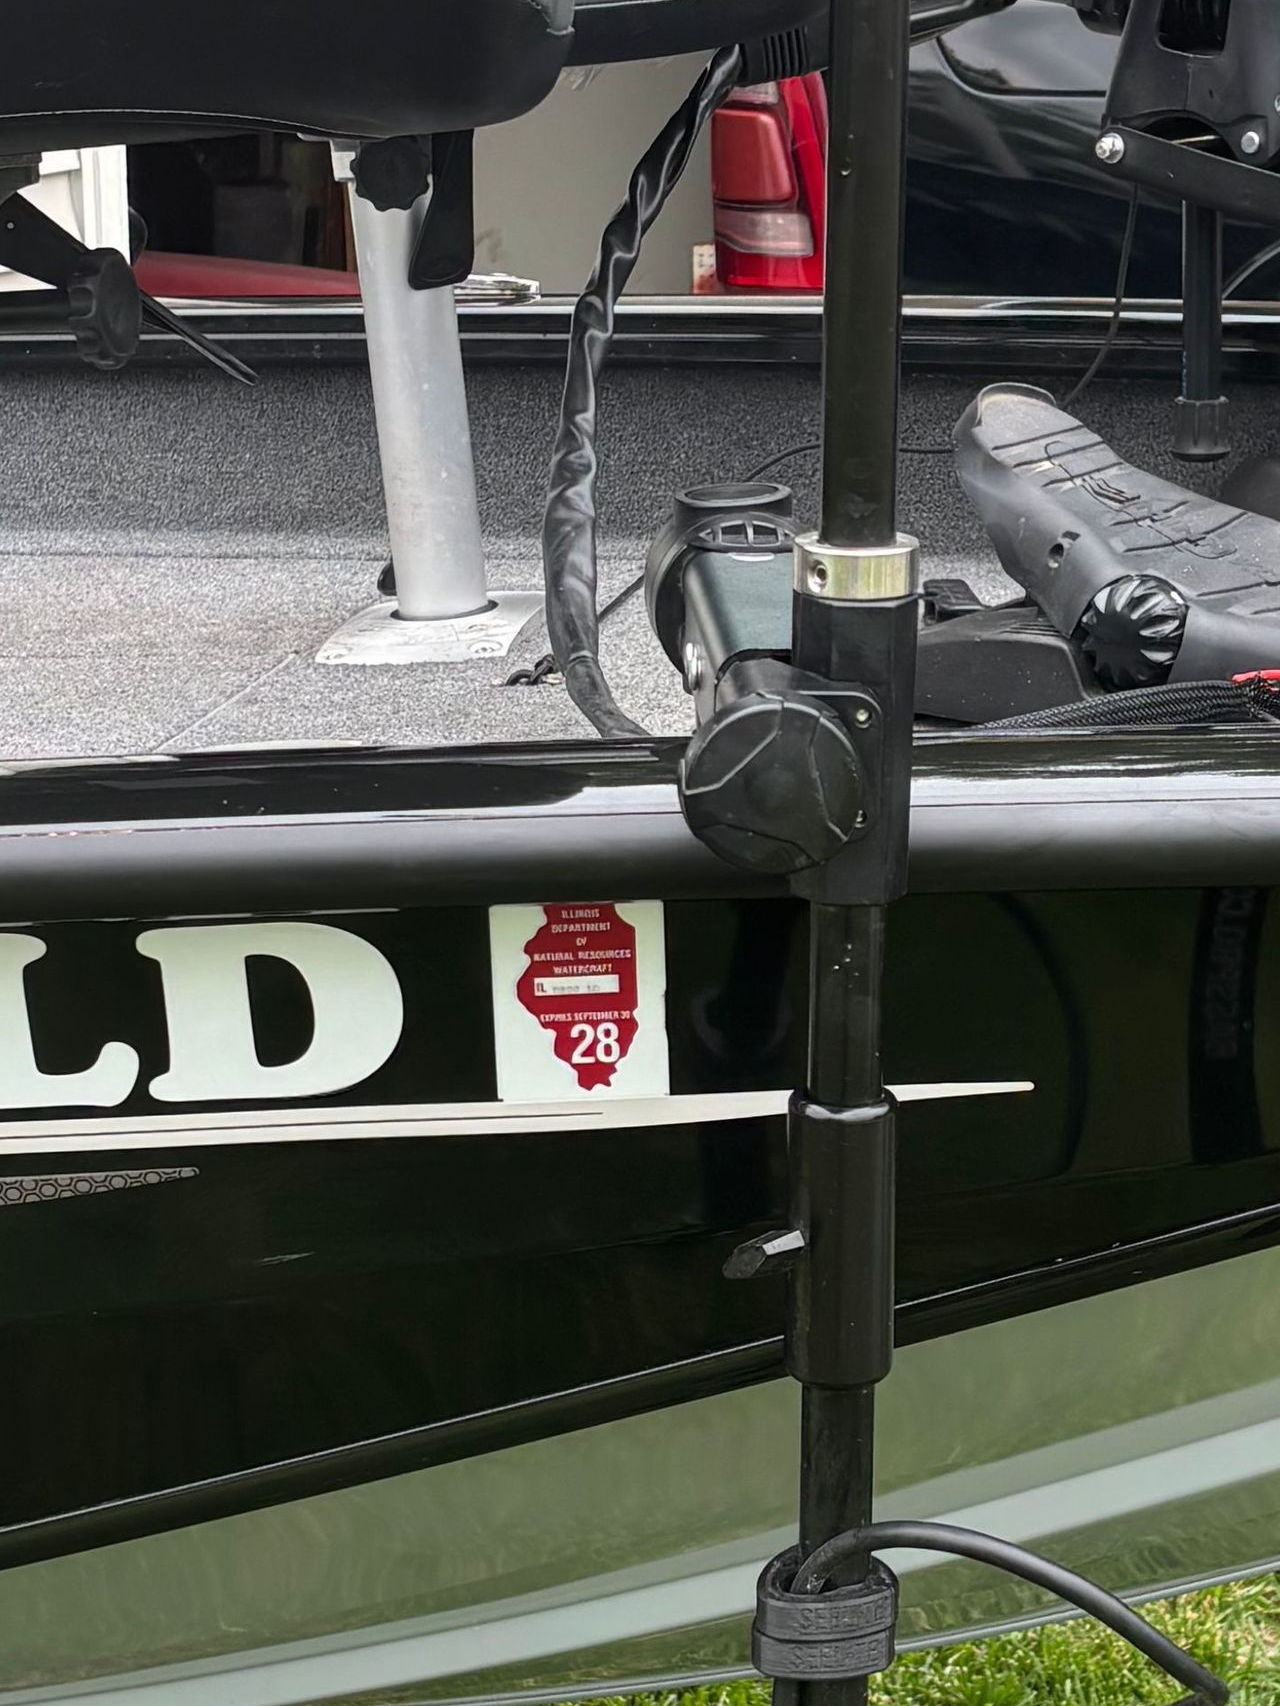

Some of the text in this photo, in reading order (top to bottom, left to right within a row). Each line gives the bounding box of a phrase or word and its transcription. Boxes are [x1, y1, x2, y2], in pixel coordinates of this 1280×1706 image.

[561, 908, 600, 919] ILLINOIS
[551, 922, 611, 934] DEPARTMENT
[533, 949, 631, 962] NATURAL RESOURCES
[553, 964, 612, 975] WATERCRAFT
[540, 1011, 572, 1023] EXPIRES
[573, 1009, 619, 1021] SEPTEMBER
[570, 1022, 620, 1064] 28
